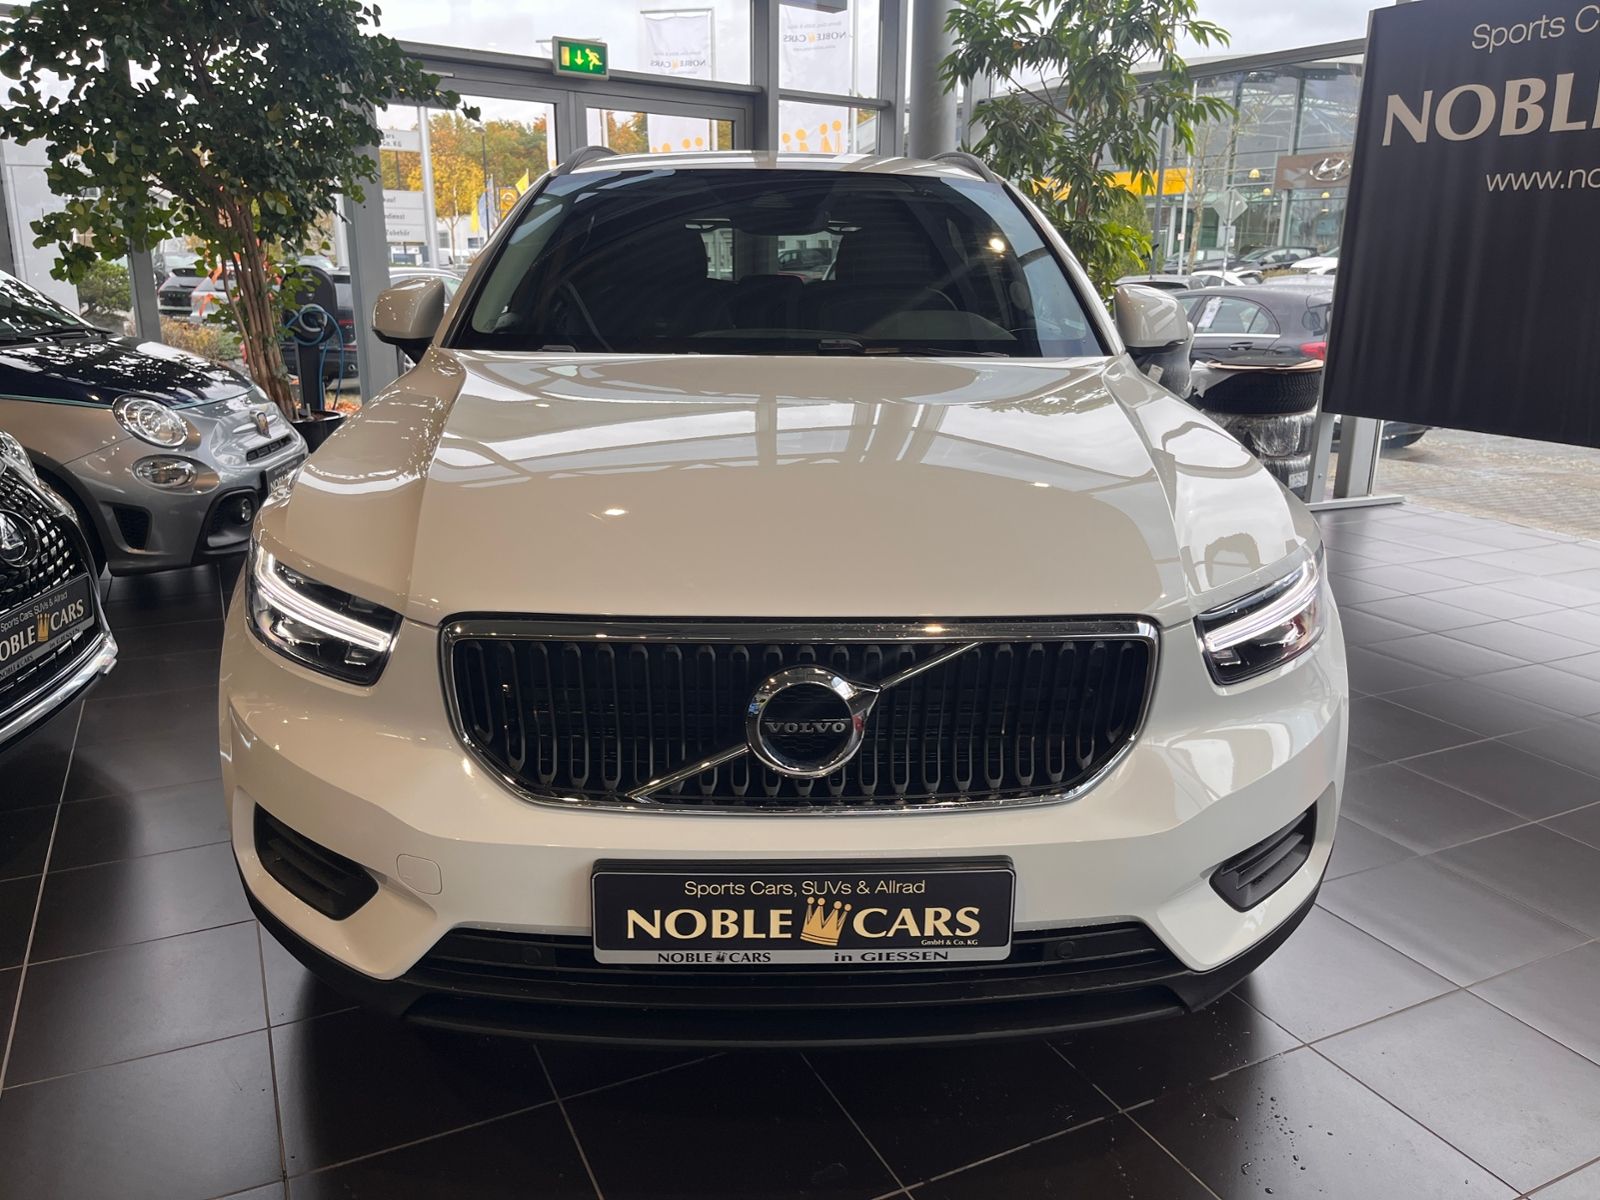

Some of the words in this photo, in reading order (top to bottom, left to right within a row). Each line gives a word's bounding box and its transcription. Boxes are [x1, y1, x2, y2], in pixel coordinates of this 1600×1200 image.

[1472, 14, 1566, 54] Sports
[1382, 72, 1600, 146] NOBL
[0, 616, 20, 633] Sports
[50, 599, 84, 631] CARS
[765, 722, 846, 733] VOLVO
[684, 880, 745, 898] Sports
[750, 880, 797, 897] Cars,
[801, 880, 852, 895] SUVs
[856, 880, 870, 894] &
[875, 879, 925, 894] Allrad
[627, 908, 792, 940] NOBLE
[852, 906, 980, 938] CARS
[658, 952, 713, 963] NOBLE
[729, 952, 771, 963] CARS
[834, 952, 852, 962] in
[860, 951, 948, 962] GIESSEN
